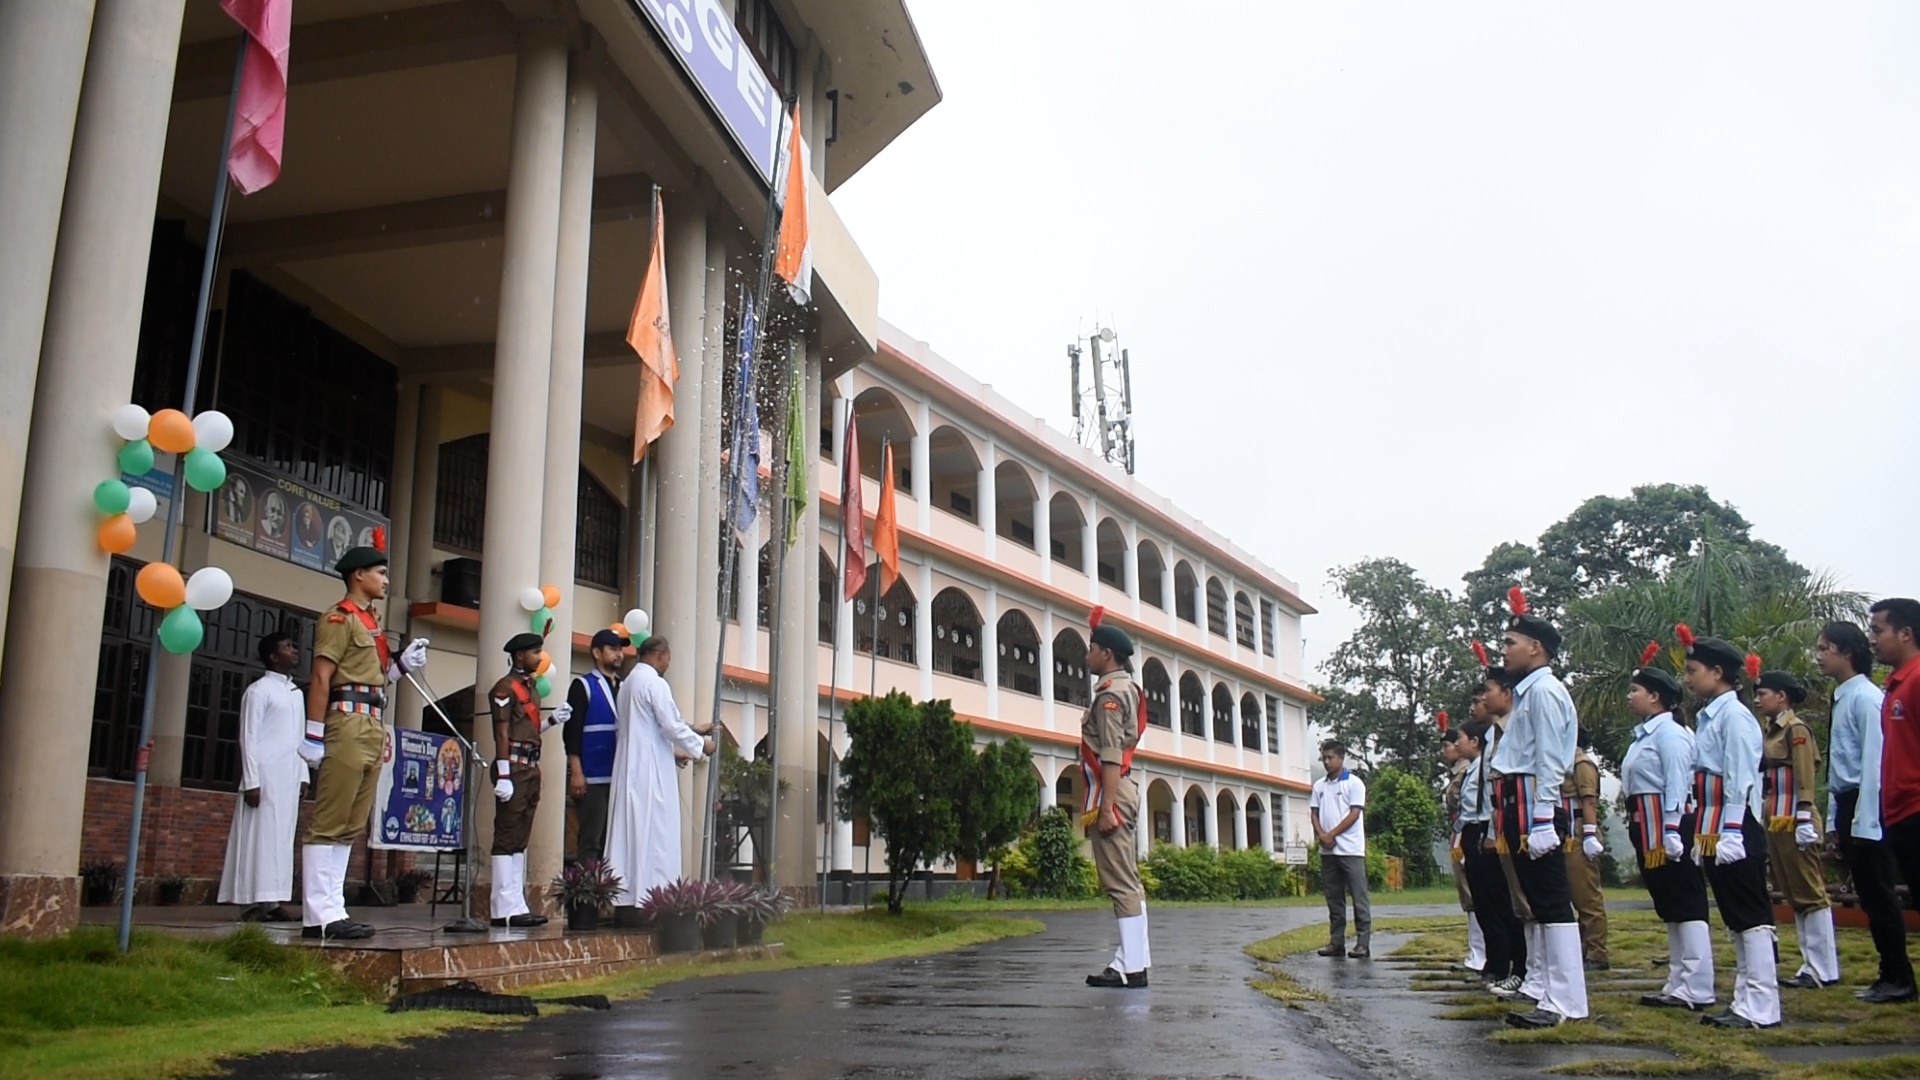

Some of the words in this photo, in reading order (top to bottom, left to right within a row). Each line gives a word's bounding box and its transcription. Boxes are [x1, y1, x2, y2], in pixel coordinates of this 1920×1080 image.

[680, 0, 767, 128] GE
[277, 478, 305, 498] CORE
[306, 490, 341, 512] VALUES
[427, 741, 438, 759] Day
